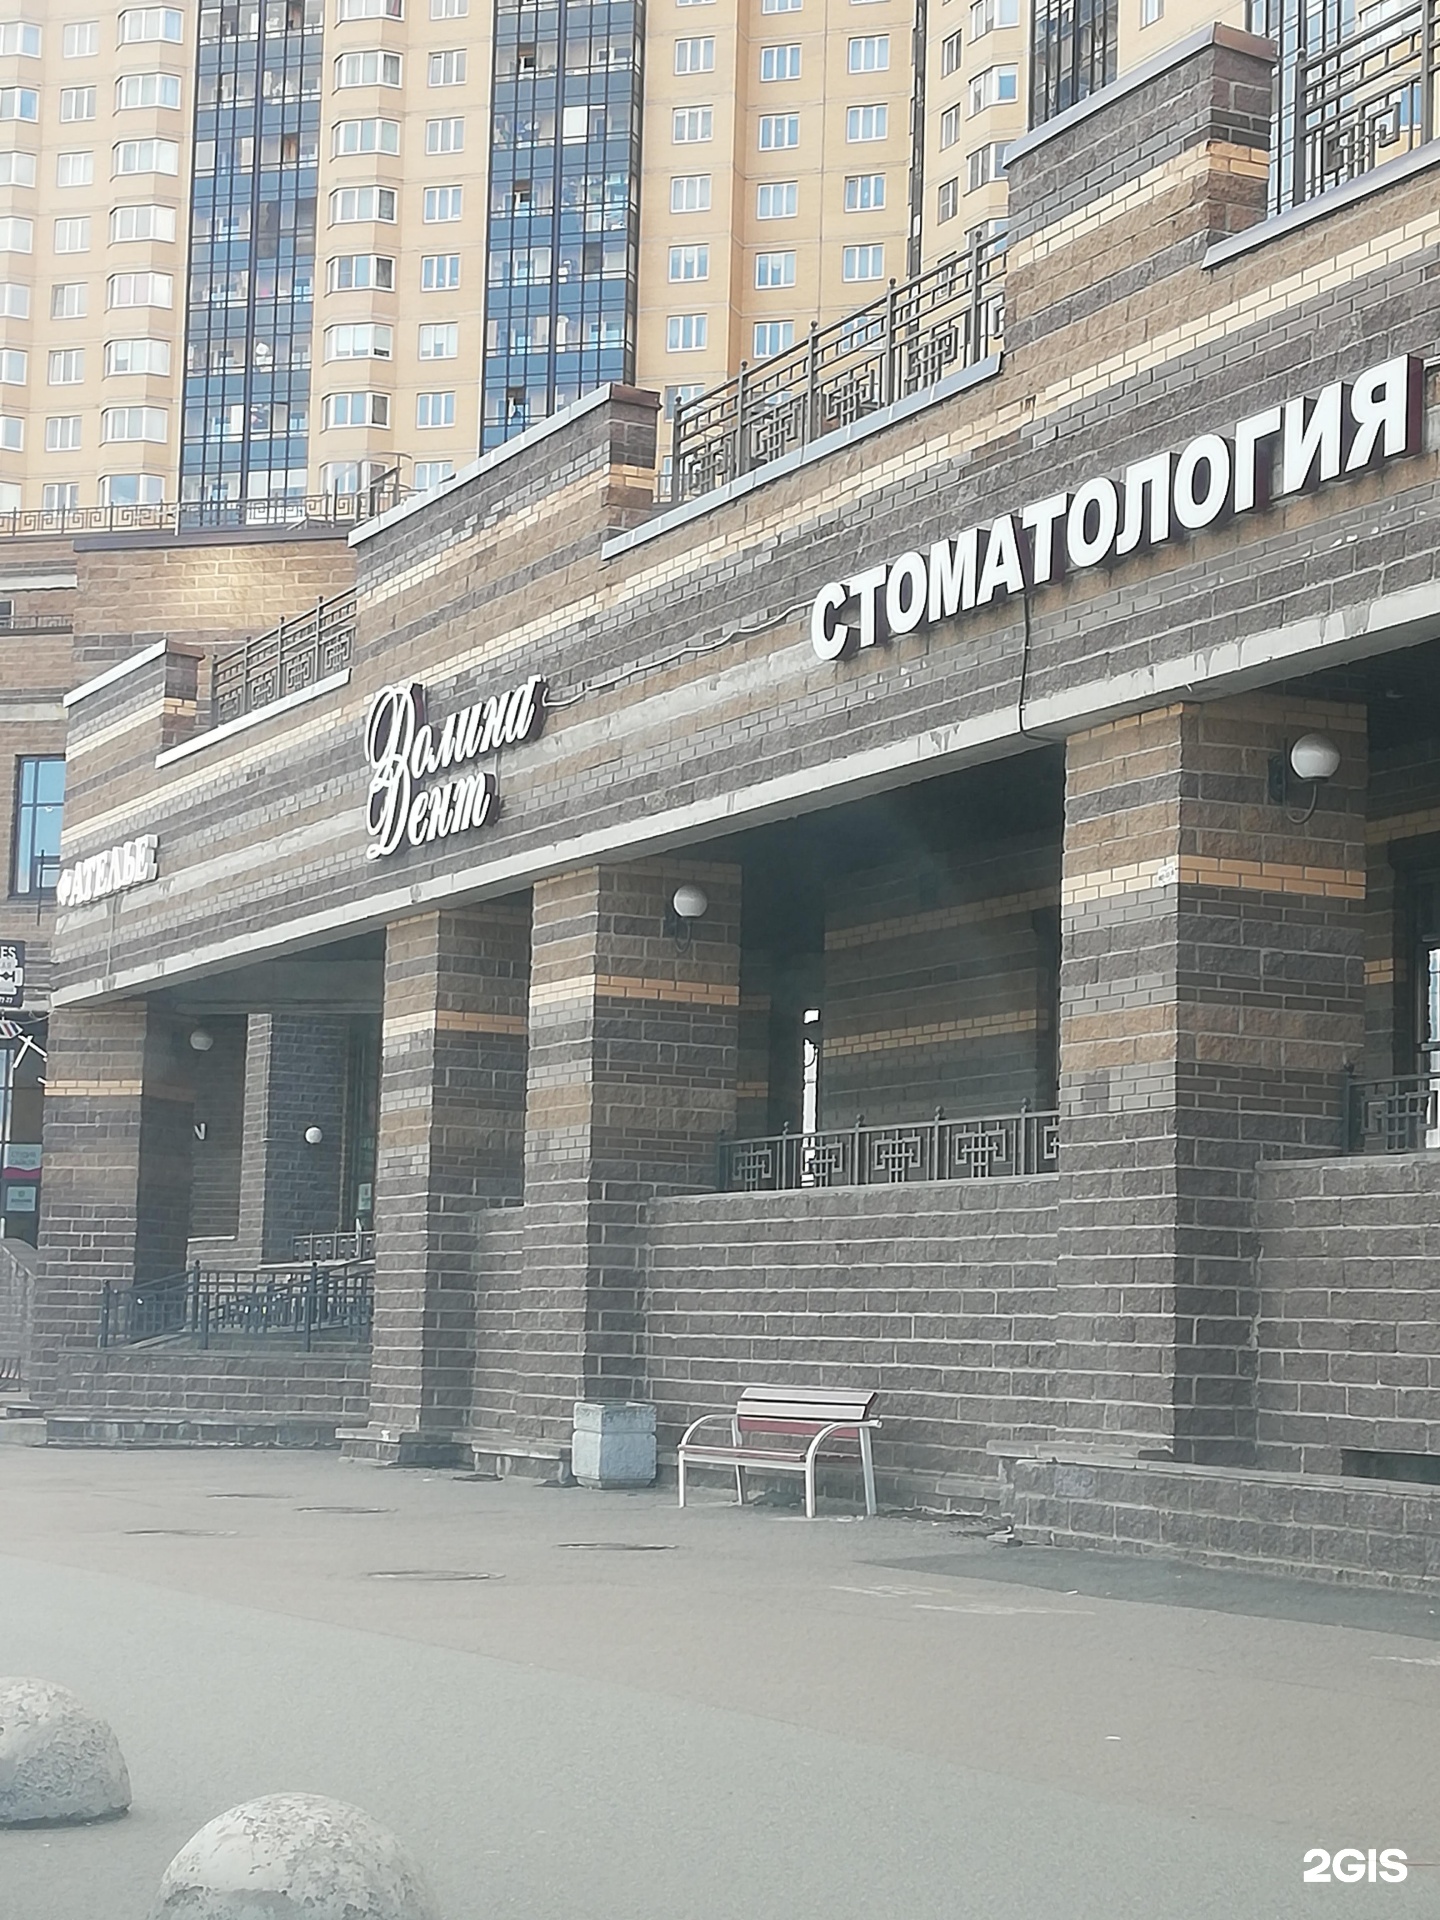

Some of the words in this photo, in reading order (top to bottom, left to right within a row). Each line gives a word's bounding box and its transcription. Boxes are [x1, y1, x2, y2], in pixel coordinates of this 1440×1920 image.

[812, 353, 1409, 661] СТОМАТОЛОГИЯ
[364, 674, 542, 779] Долина
[366, 755, 492, 860] Дент
